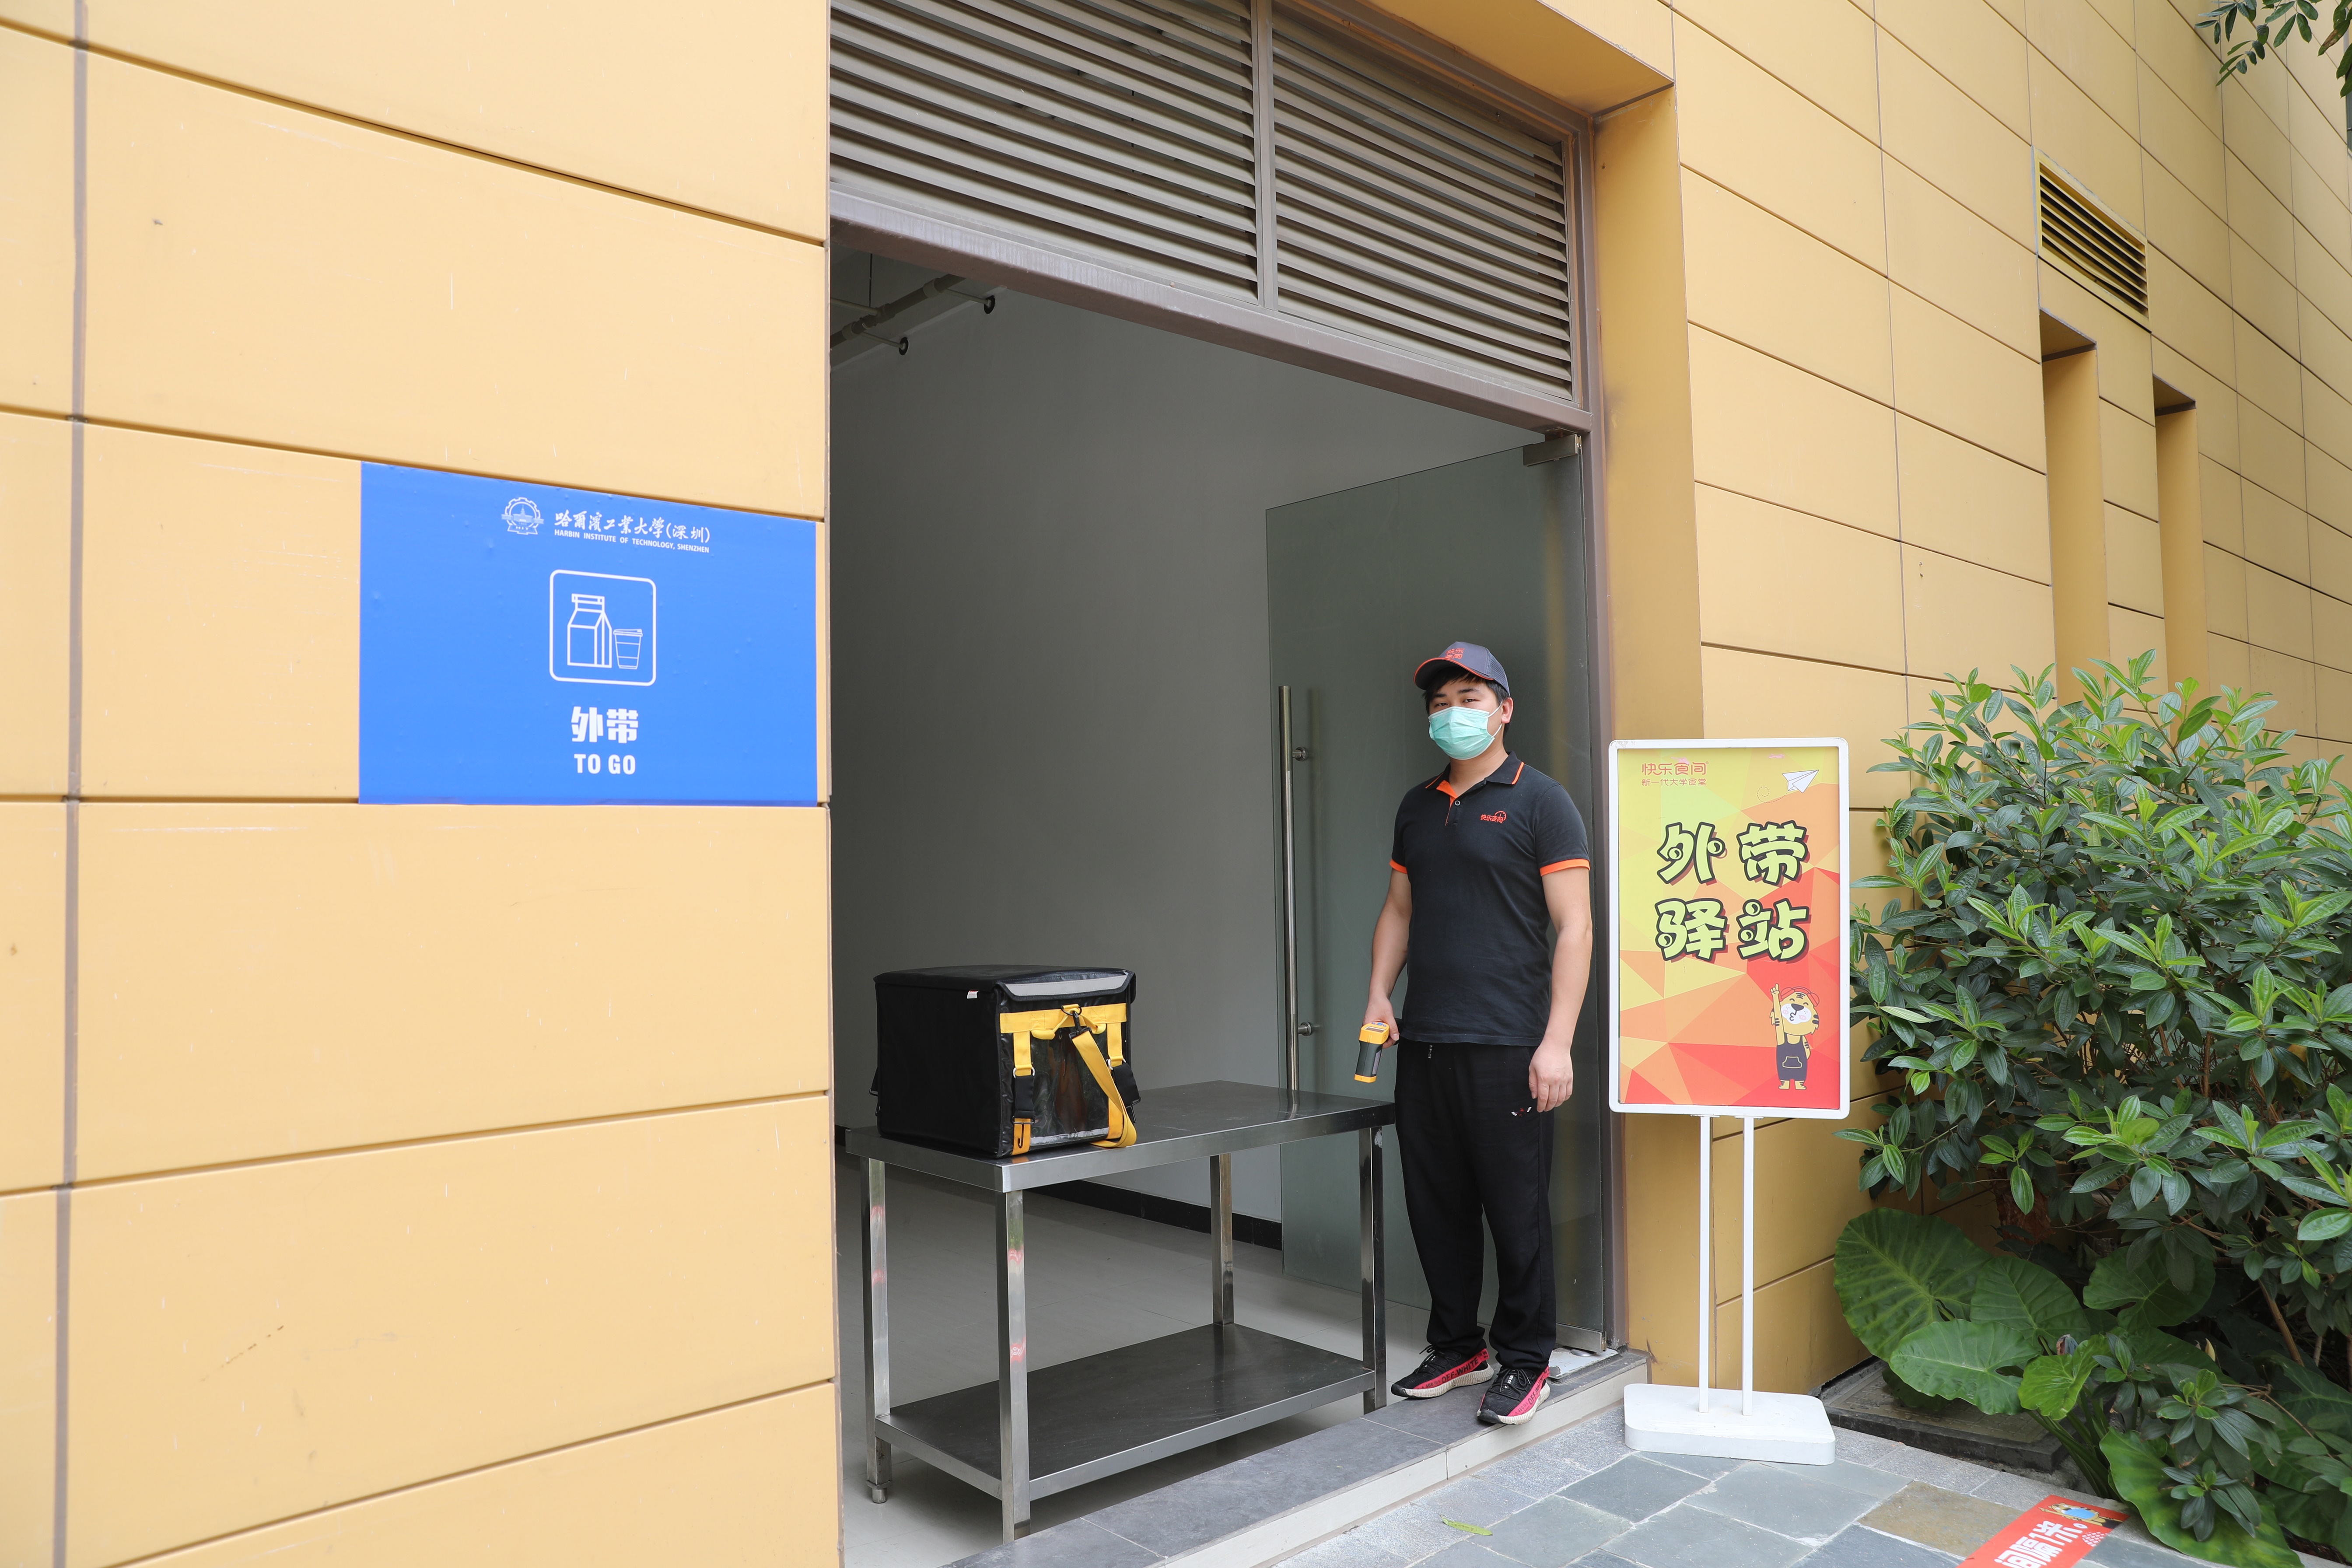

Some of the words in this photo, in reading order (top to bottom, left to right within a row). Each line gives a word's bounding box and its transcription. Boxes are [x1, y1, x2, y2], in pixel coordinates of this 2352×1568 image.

[555, 529, 580, 538] HARBIN
[584, 532, 616, 542] INSTITUTE
[632, 538, 675, 550] TECHNOLOGY,
[677, 543, 709, 553] SHENZHEN
[571, 706, 638, 743] 外带
[574, 754, 601, 774] TO
[608, 755, 636, 775] GO
[1657, 820, 1808, 885] 外带
[1655, 898, 1810, 962] 驿站
[1442, 1357, 1478, 1383] OFF-WHITE
